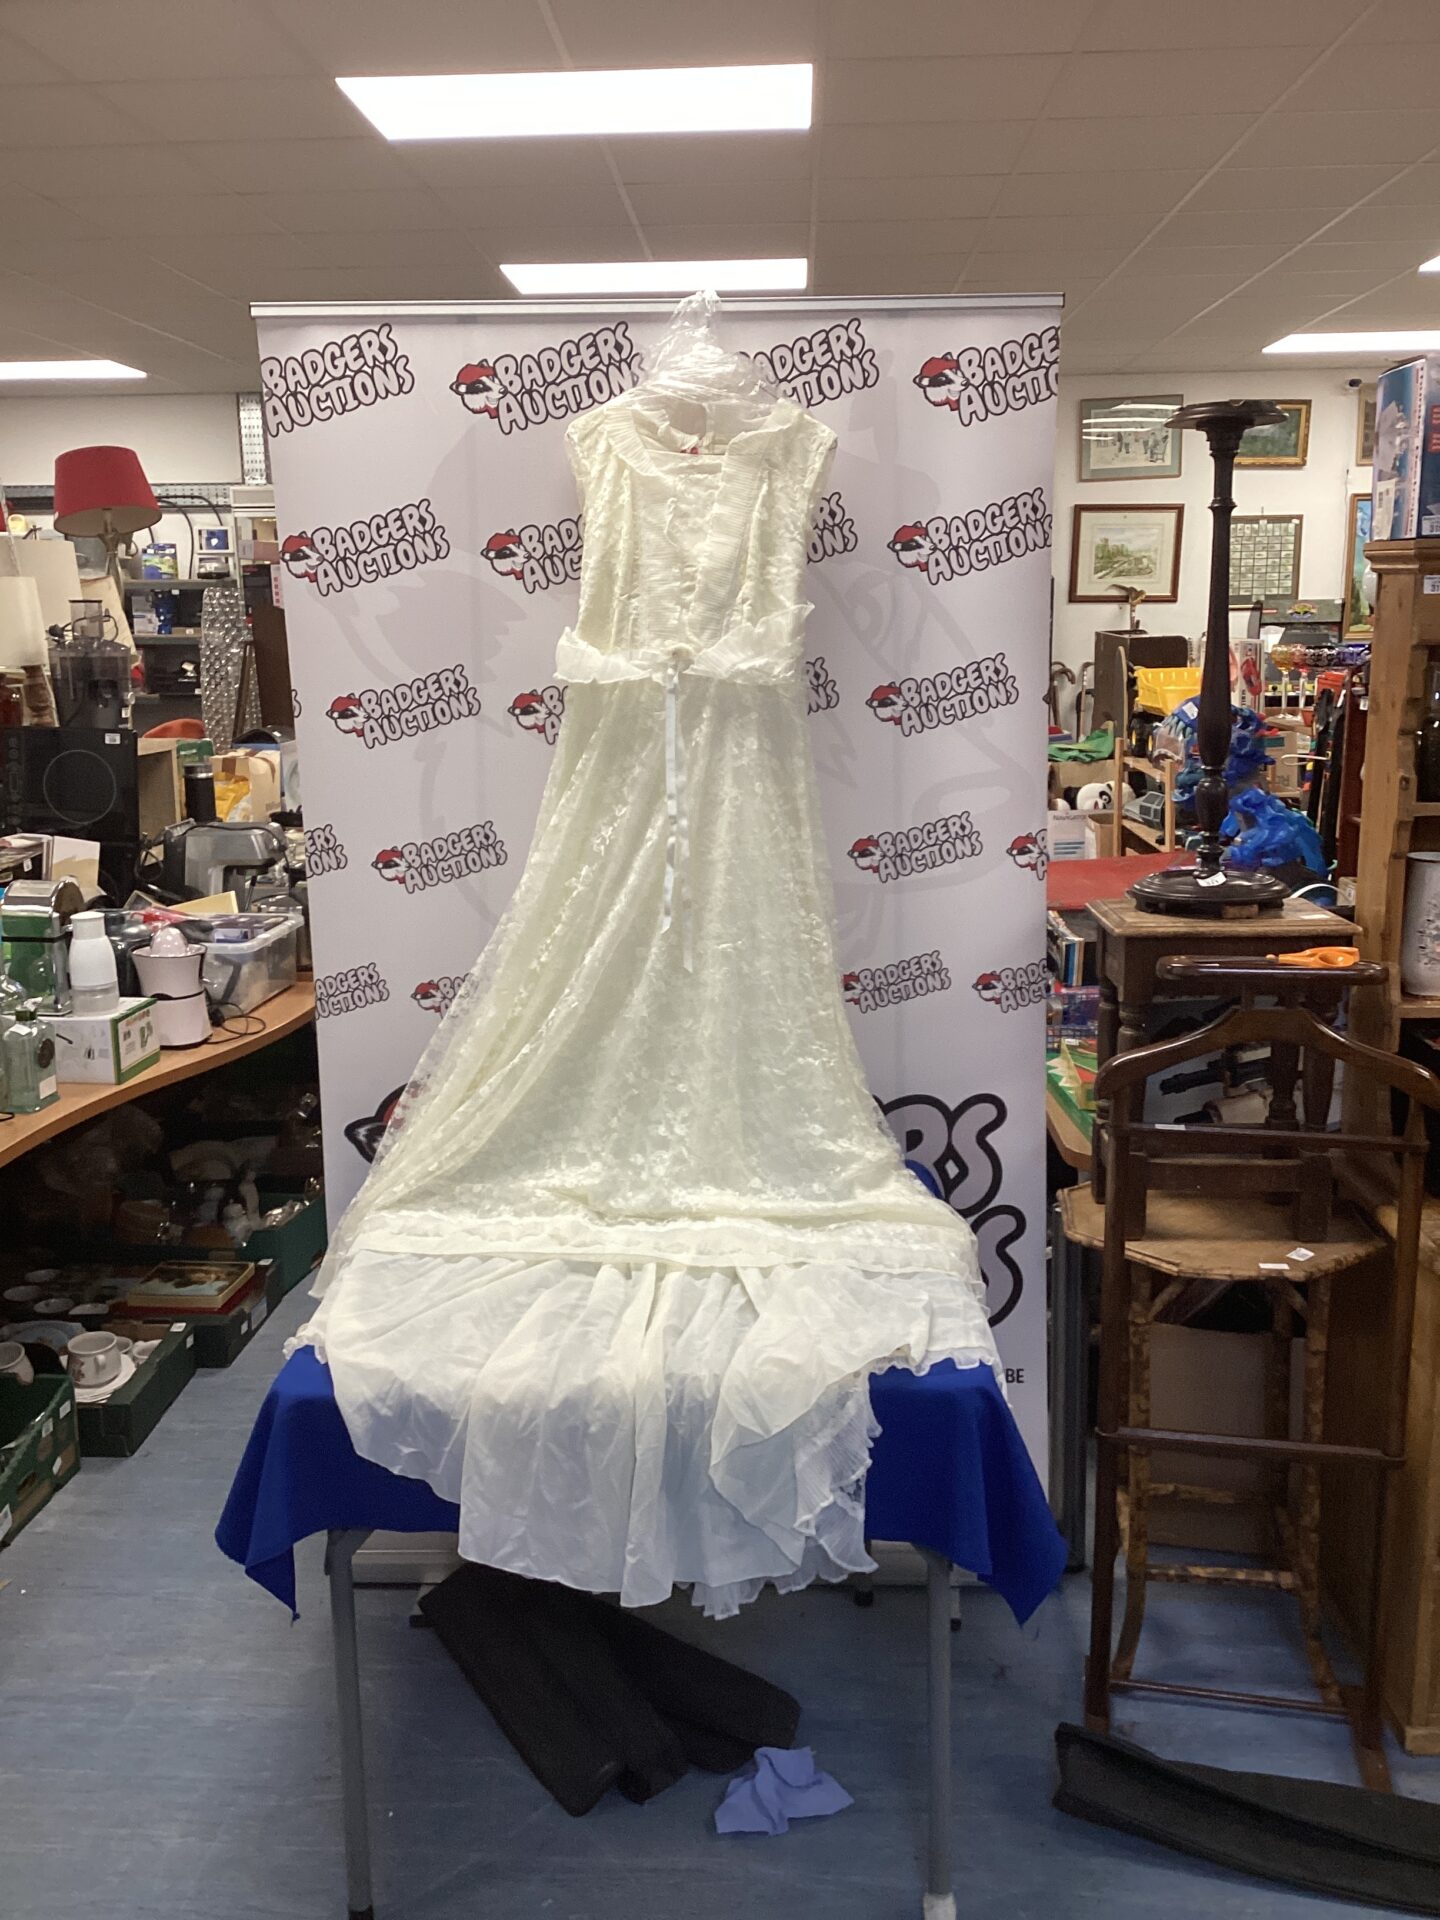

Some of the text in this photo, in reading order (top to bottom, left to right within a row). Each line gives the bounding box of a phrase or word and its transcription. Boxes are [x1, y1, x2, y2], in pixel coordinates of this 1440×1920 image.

[260, 323, 398, 398] BADGERS
[493, 321, 633, 396] BADGERS
[739, 317, 866, 385] ADGERS
[957, 325, 1060, 388] BADGE
[264, 354, 415, 438] AUCTIONS
[311, 498, 436, 562] BADGERS
[926, 487, 1046, 553] BADGERS
[927, 514, 1052, 585] AUCTIONS
[316, 525, 450, 597] AUCTIONS
[359, 664, 469, 720] BADGERS
[899, 652, 1009, 708] BADGERS
[900, 675, 1019, 737] AUCTIONS
[363, 687, 481, 749] AUCTIONS
[401, 820, 497, 869] BADGERS
[877, 811, 973, 858] BADGERS
[878, 831, 983, 884] AUCTIONS
[404, 840, 508, 895] AUCTIONS
[314, 962, 380, 999] ADGERS
[315, 979, 390, 1020] UCTIONS
[858, 949, 943, 991] BADGERS
[859, 967, 952, 1014] AUCTIONS
